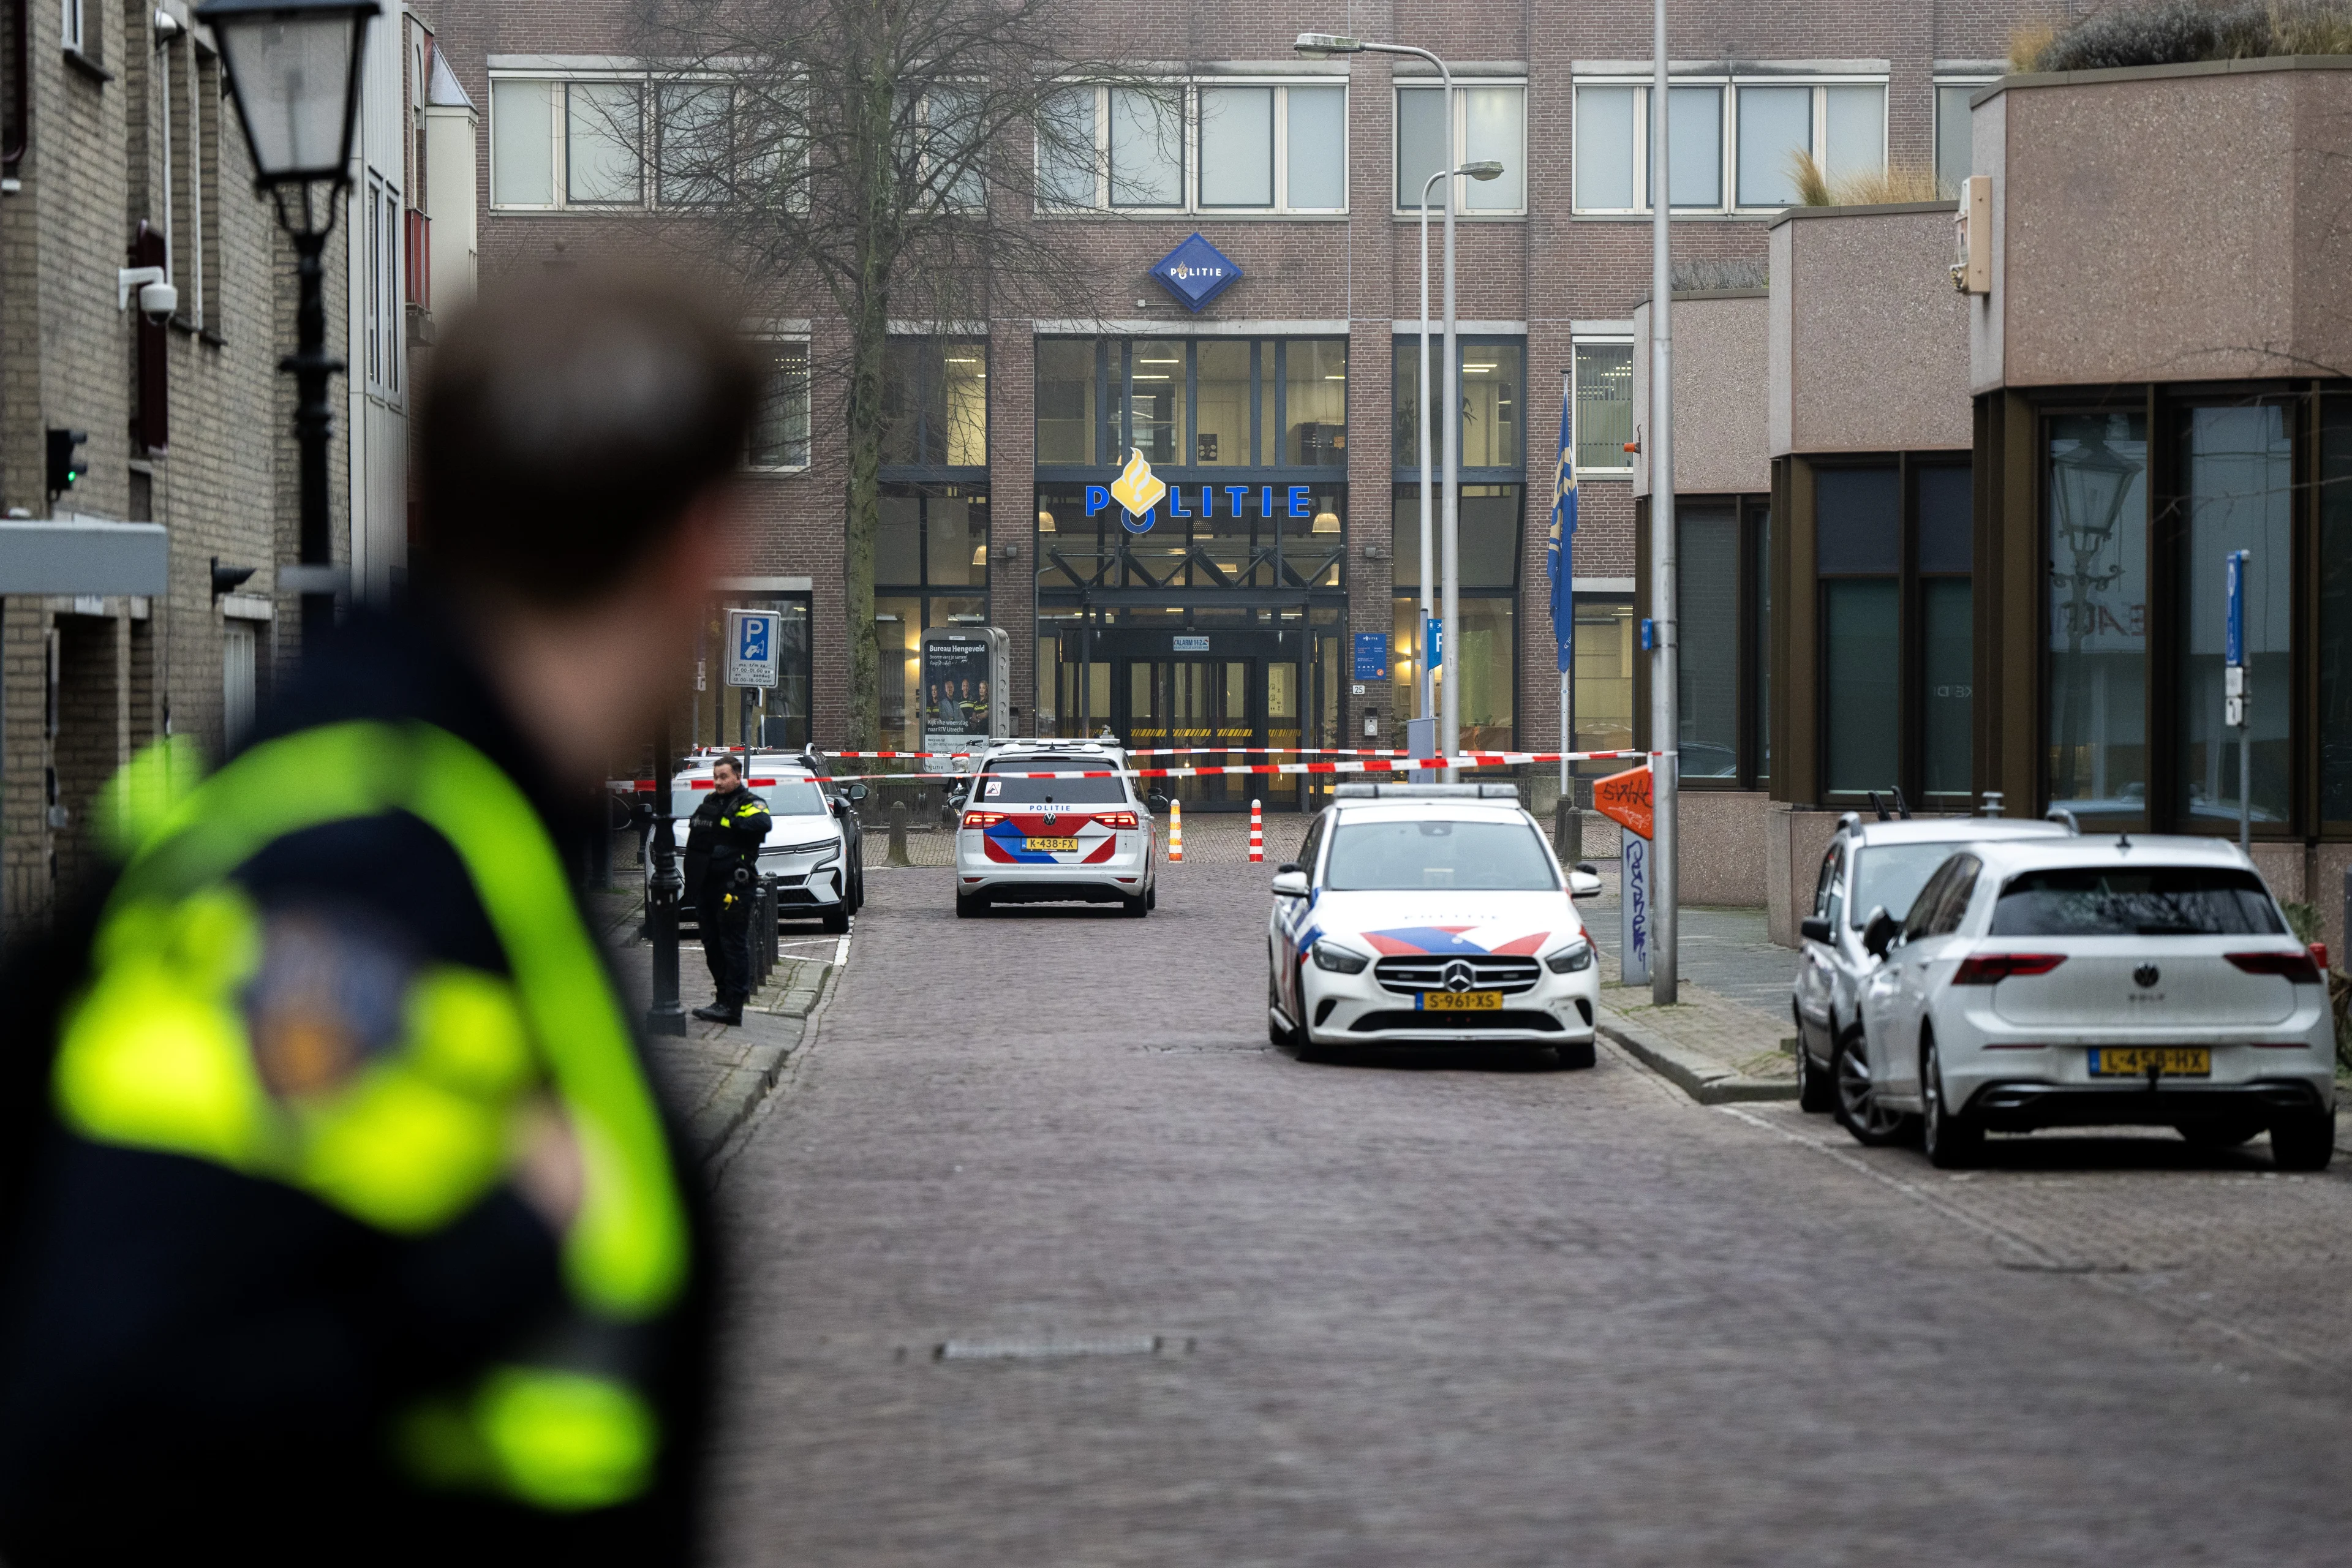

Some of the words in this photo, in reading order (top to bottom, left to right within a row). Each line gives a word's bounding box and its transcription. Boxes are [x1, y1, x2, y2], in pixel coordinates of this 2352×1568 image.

[1170, 267, 1222, 280] POLITIE
[1085, 485, 1310, 534] POLITIE
[746, 619, 763, 643] P
[952, 644, 985, 654] Hengeveld
[1030, 839, 1074, 848] K-438-FX
[1429, 993, 1495, 1008] S-961-XS
